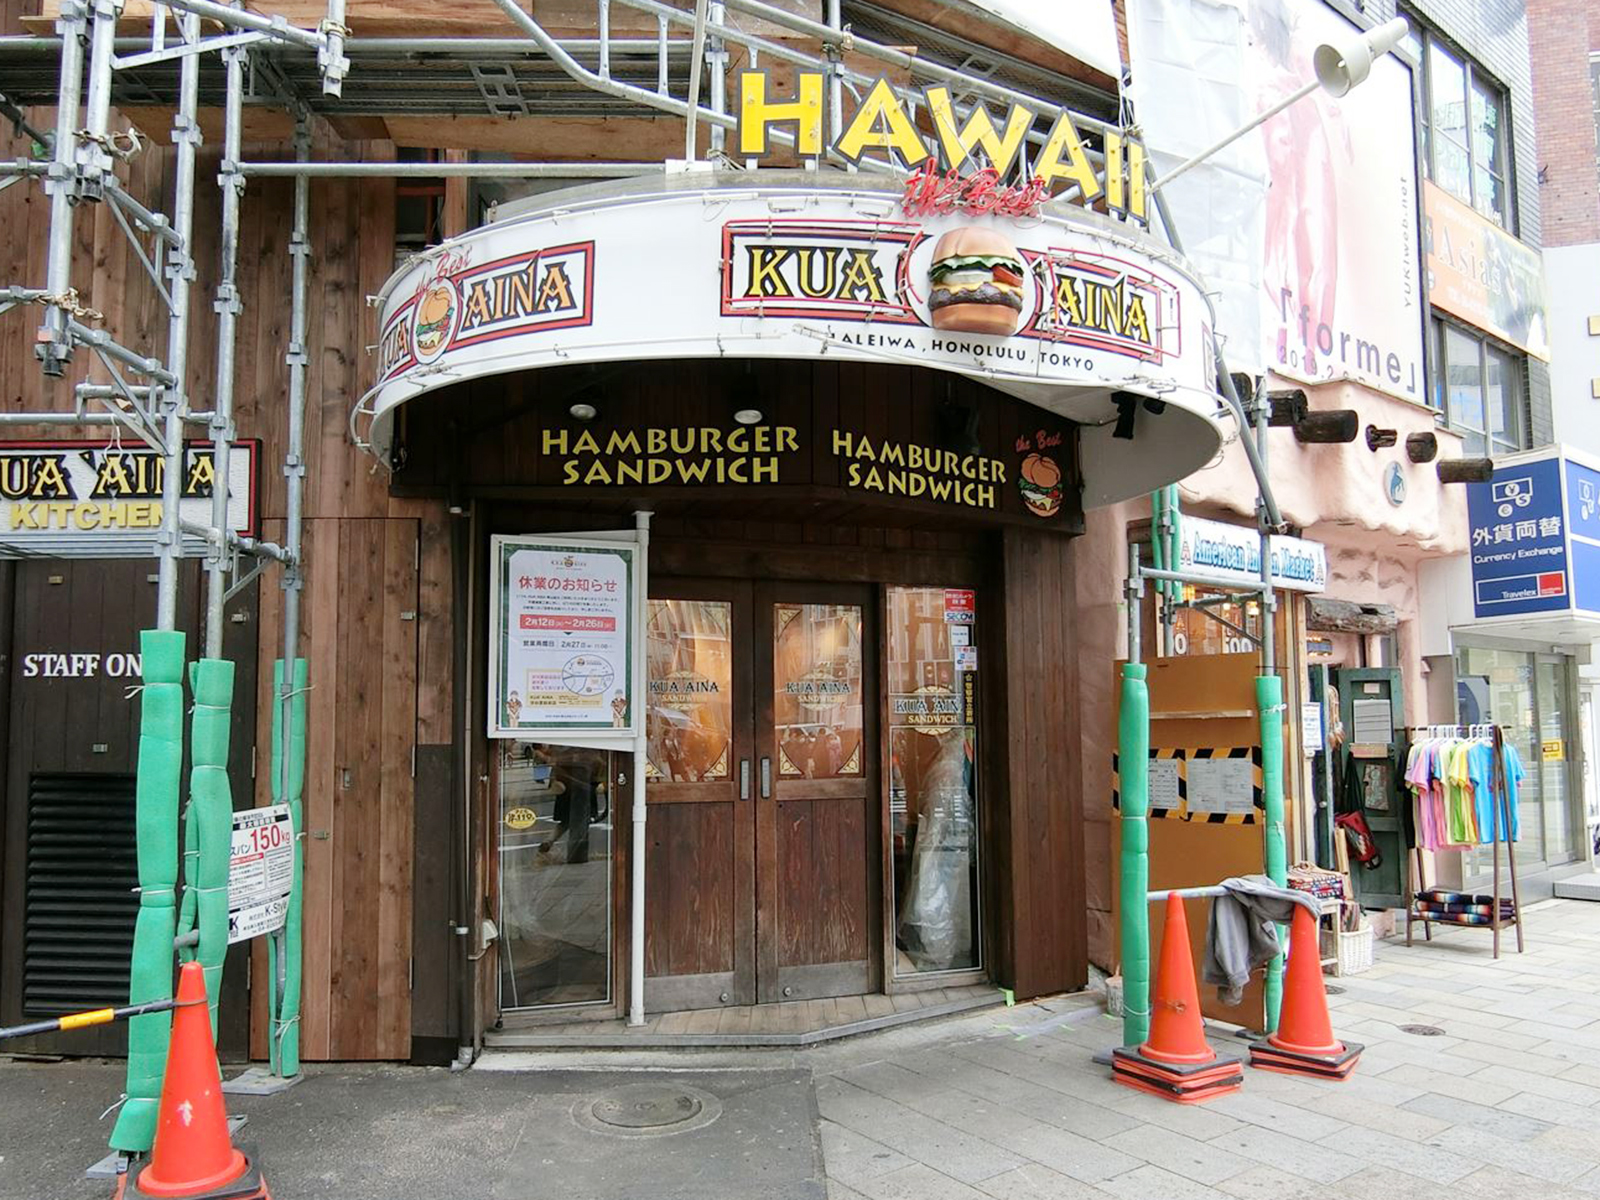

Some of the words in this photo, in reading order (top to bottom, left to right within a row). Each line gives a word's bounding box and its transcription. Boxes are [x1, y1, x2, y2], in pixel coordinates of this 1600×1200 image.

[738, 69, 1148, 225] HAWAII
[742, 244, 892, 306] KUA
[460, 255, 578, 334] AINA
[1050, 268, 1156, 347] AINA
[1039, 352, 1095, 371] TOKYO
[541, 425, 800, 457] HAMBURGER
[562, 456, 779, 486] SANDWICH
[831, 429, 1007, 485] HAMBURGER
[848, 462, 996, 509] SANDWICH
[1472, 516, 1562, 547] 外貨両替
[1193, 531, 1246, 572] American
[1281, 547, 1315, 582] Market
[1474, 552, 1517, 565] Currency
[1517, 545, 1563, 559] Exchange
[519, 576, 618, 593] 休業のお知らせ
[1501, 589, 1537, 599] Travelex
[946, 612, 974, 620] SECOM
[23, 654, 100, 677] STAFF
[650, 681, 679, 693] KUA
[685, 680, 719, 693] AINA
[786, 682, 813, 693] KUA
[819, 682, 851, 693] AINA
[895, 700, 927, 713] KUA
[908, 715, 958, 723] SANDWICH
[250, 824, 281, 852] 150
[281, 830, 290, 844] kg
